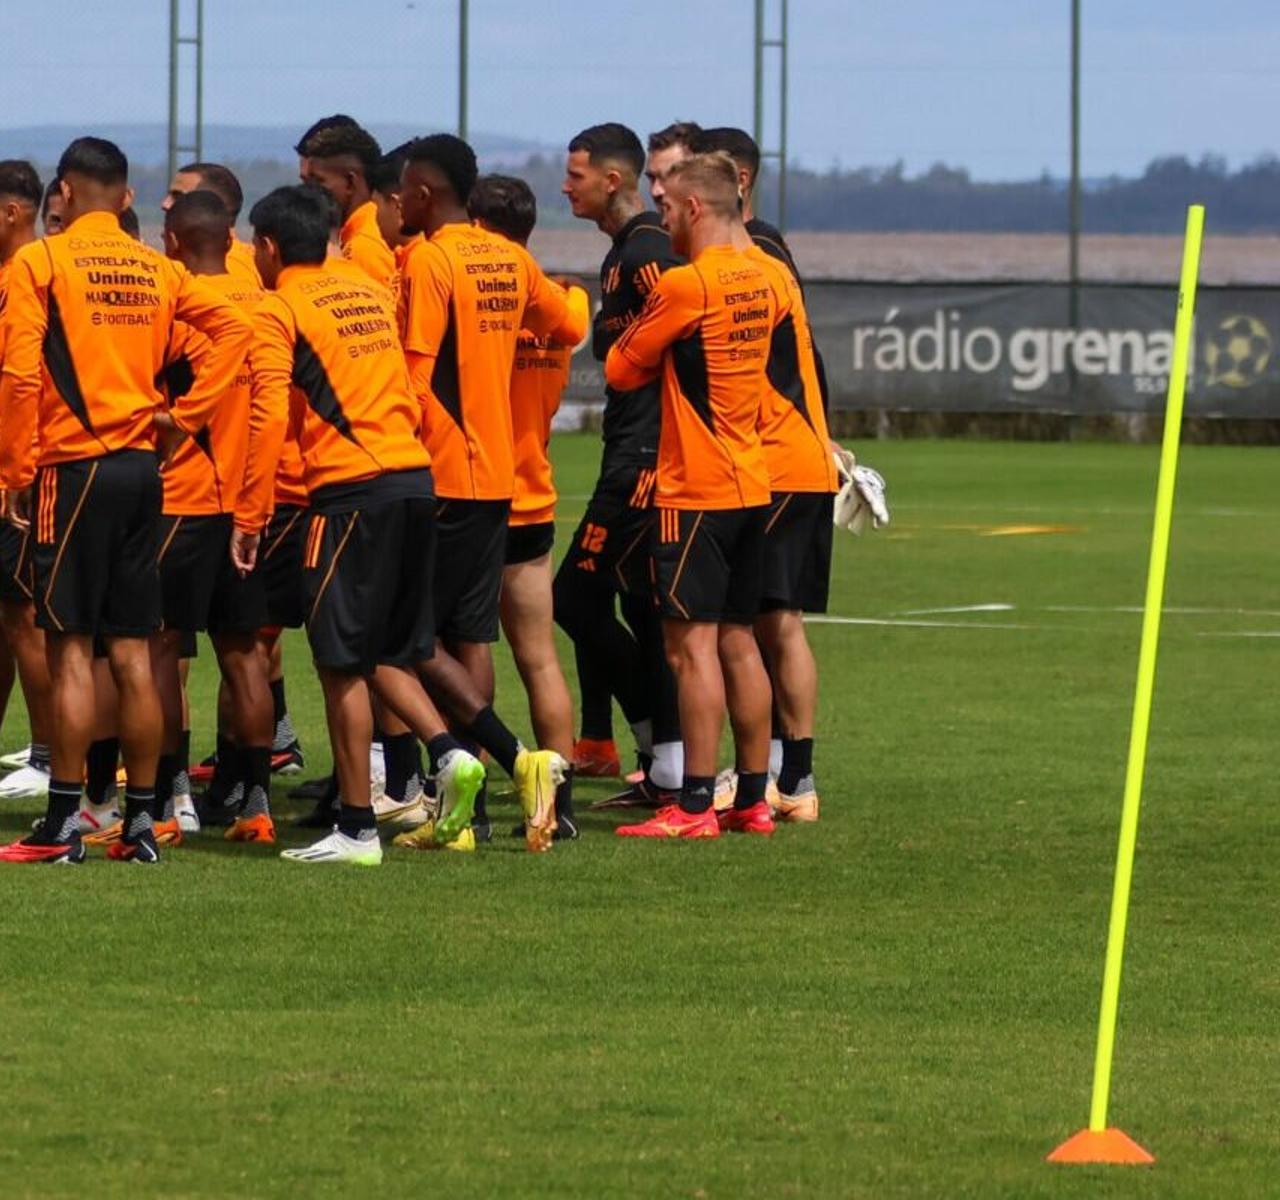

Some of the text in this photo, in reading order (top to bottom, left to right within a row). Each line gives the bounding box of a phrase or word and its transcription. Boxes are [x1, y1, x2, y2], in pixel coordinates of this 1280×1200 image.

[74, 256, 129, 268] ESTRELA
[87, 270, 156, 288] Unimed
[476, 277, 517, 293] Unimed
[733, 305, 769, 323] Unimed
[853, 306, 1002, 373] rádio
